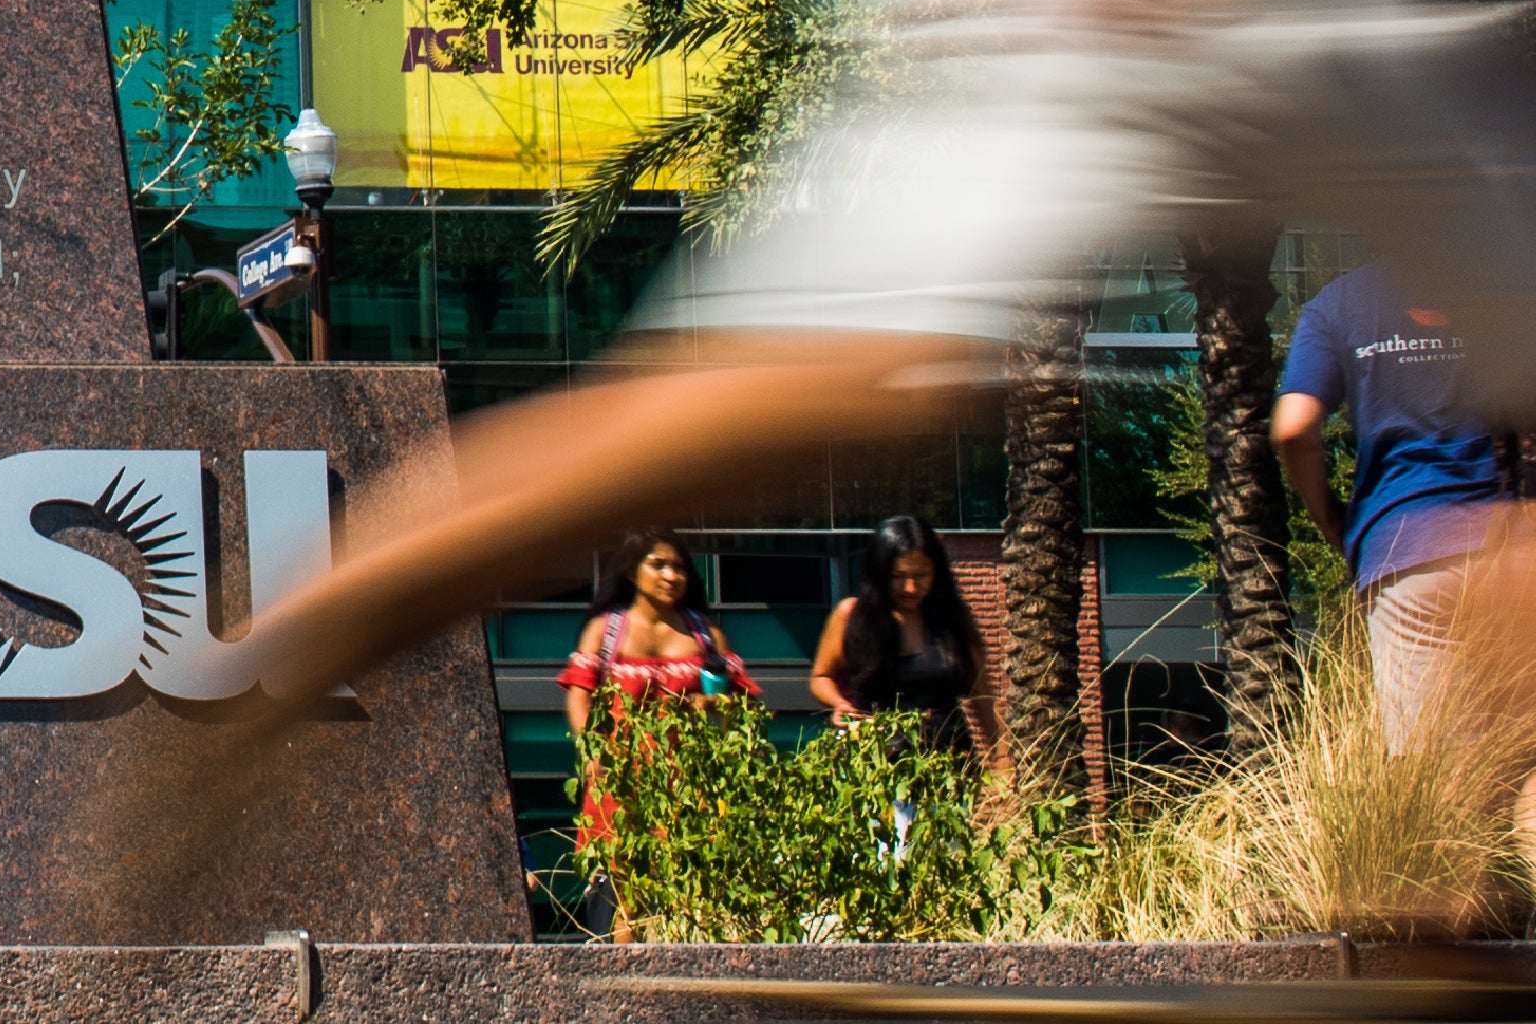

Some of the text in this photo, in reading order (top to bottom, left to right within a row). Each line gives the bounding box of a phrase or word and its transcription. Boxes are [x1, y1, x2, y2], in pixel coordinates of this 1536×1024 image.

[513, 29, 608, 49] Arizona
[515, 54, 635, 80] University
[242, 259, 268, 287] College
